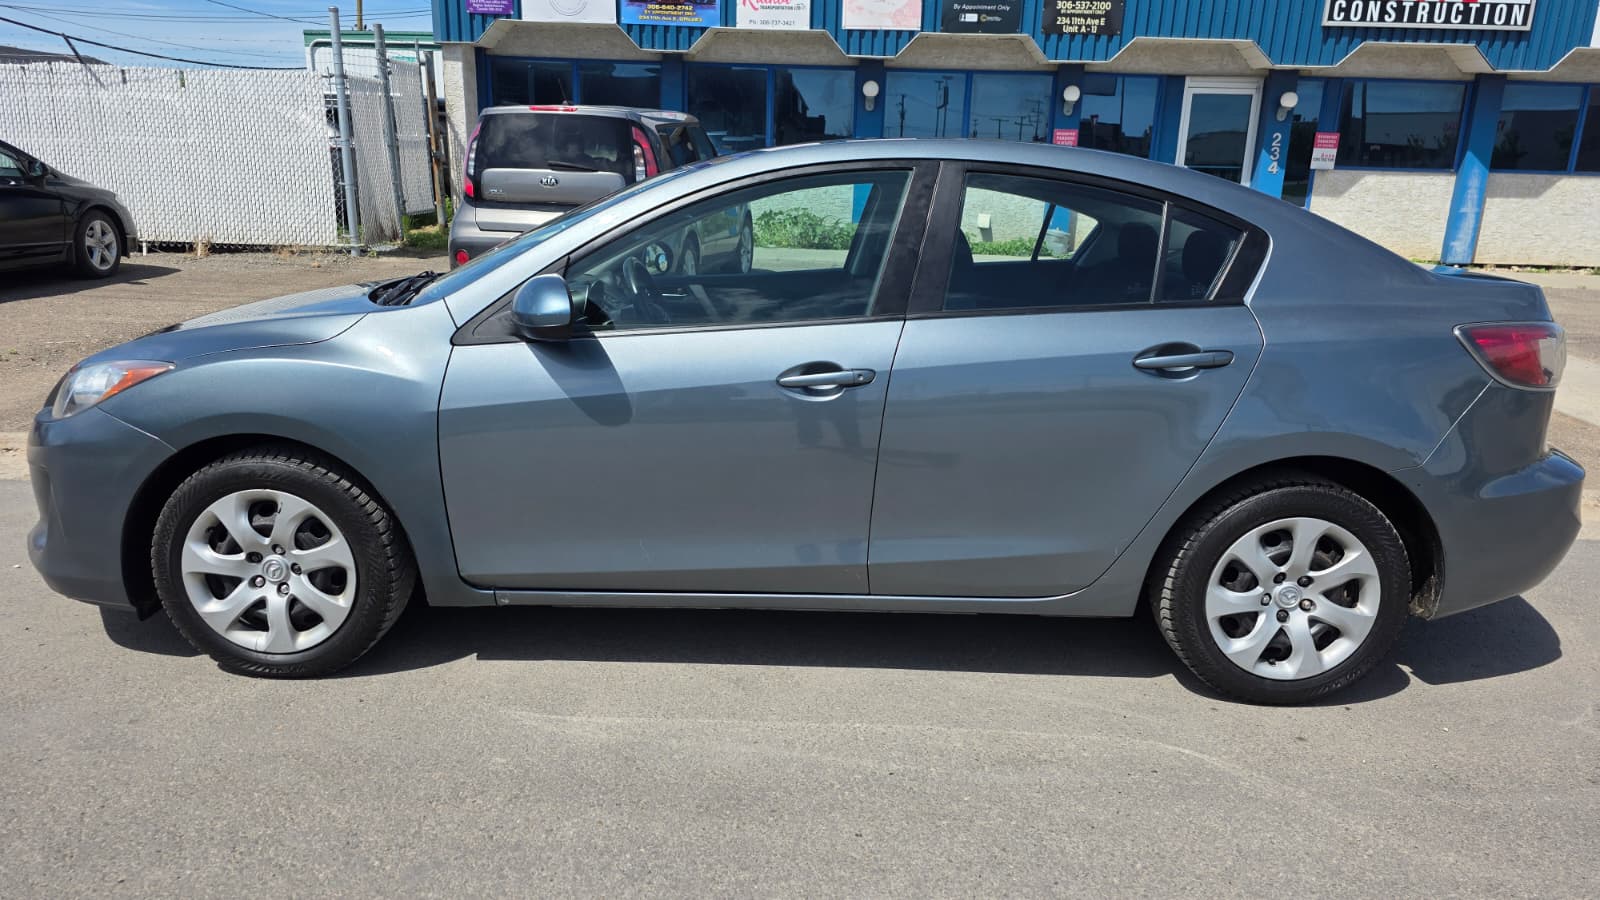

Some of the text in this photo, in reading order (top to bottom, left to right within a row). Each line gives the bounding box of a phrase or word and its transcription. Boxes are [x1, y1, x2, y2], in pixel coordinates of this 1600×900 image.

[1056, 1, 1111, 10] 306-537-2100
[1332, 1, 1526, 26] CONSTRUCTION
[1056, 17, 1106, 26] 234 11th Ave E
[1062, 25, 1079, 33] Unit
[1080, 25, 1087, 33] A
[1267, 132, 1283, 174] 234
[541, 176, 558, 187] KIA
